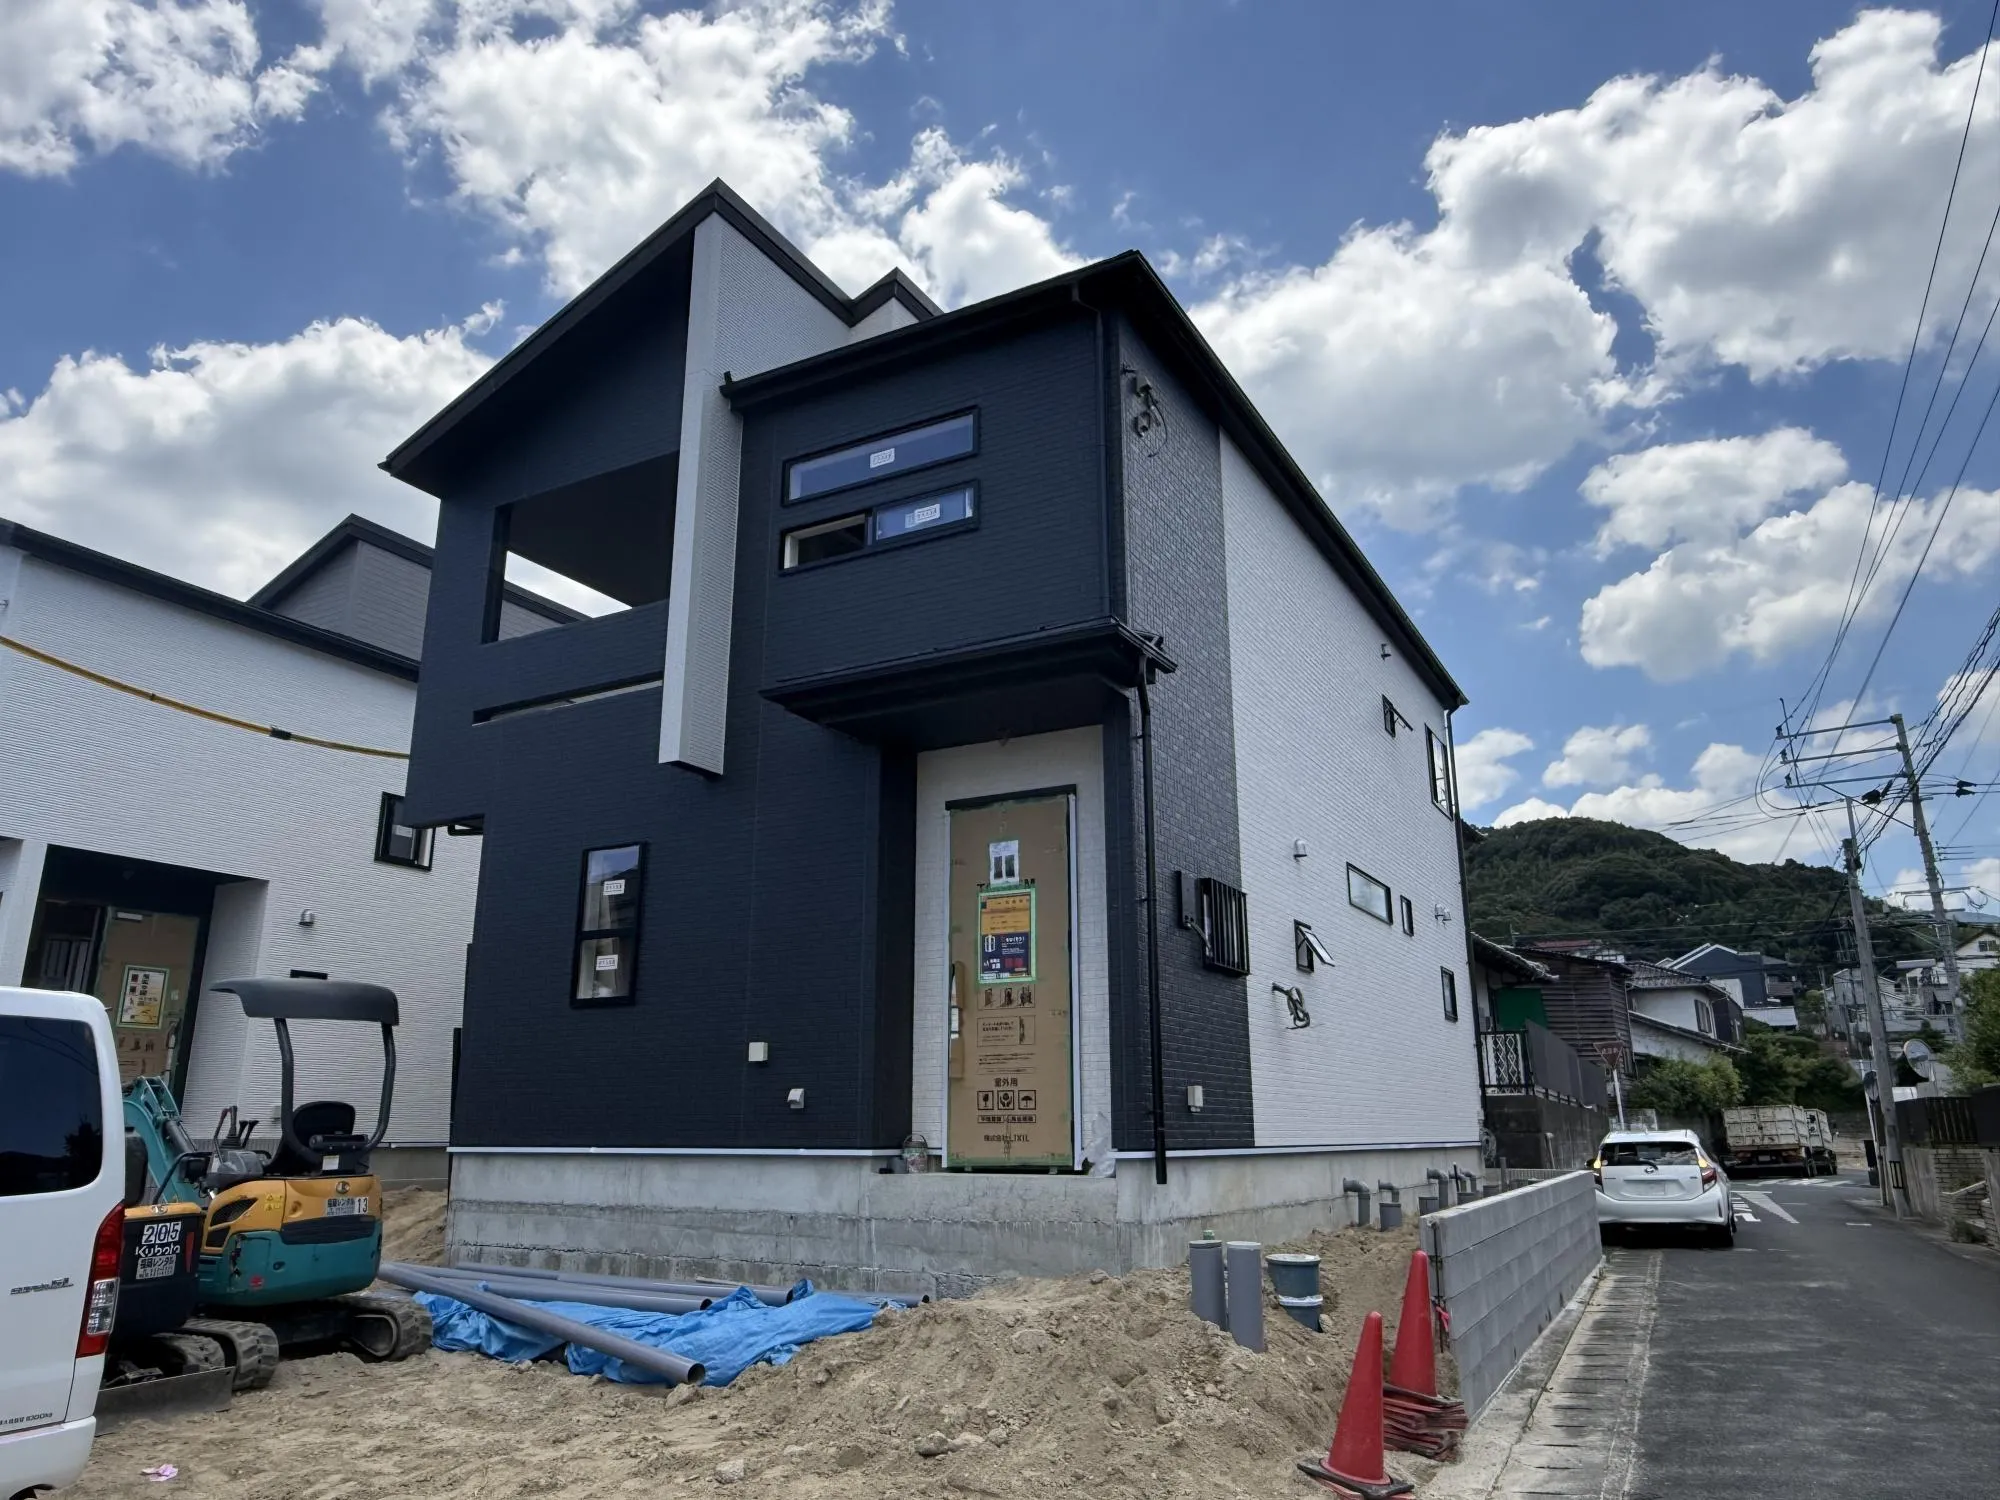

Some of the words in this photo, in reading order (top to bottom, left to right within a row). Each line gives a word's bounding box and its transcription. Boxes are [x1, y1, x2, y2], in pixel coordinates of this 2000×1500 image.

[357, 1197, 368, 1213] 13
[142, 1222, 181, 1244] 205
[135, 1242, 181, 1257] Kubota
